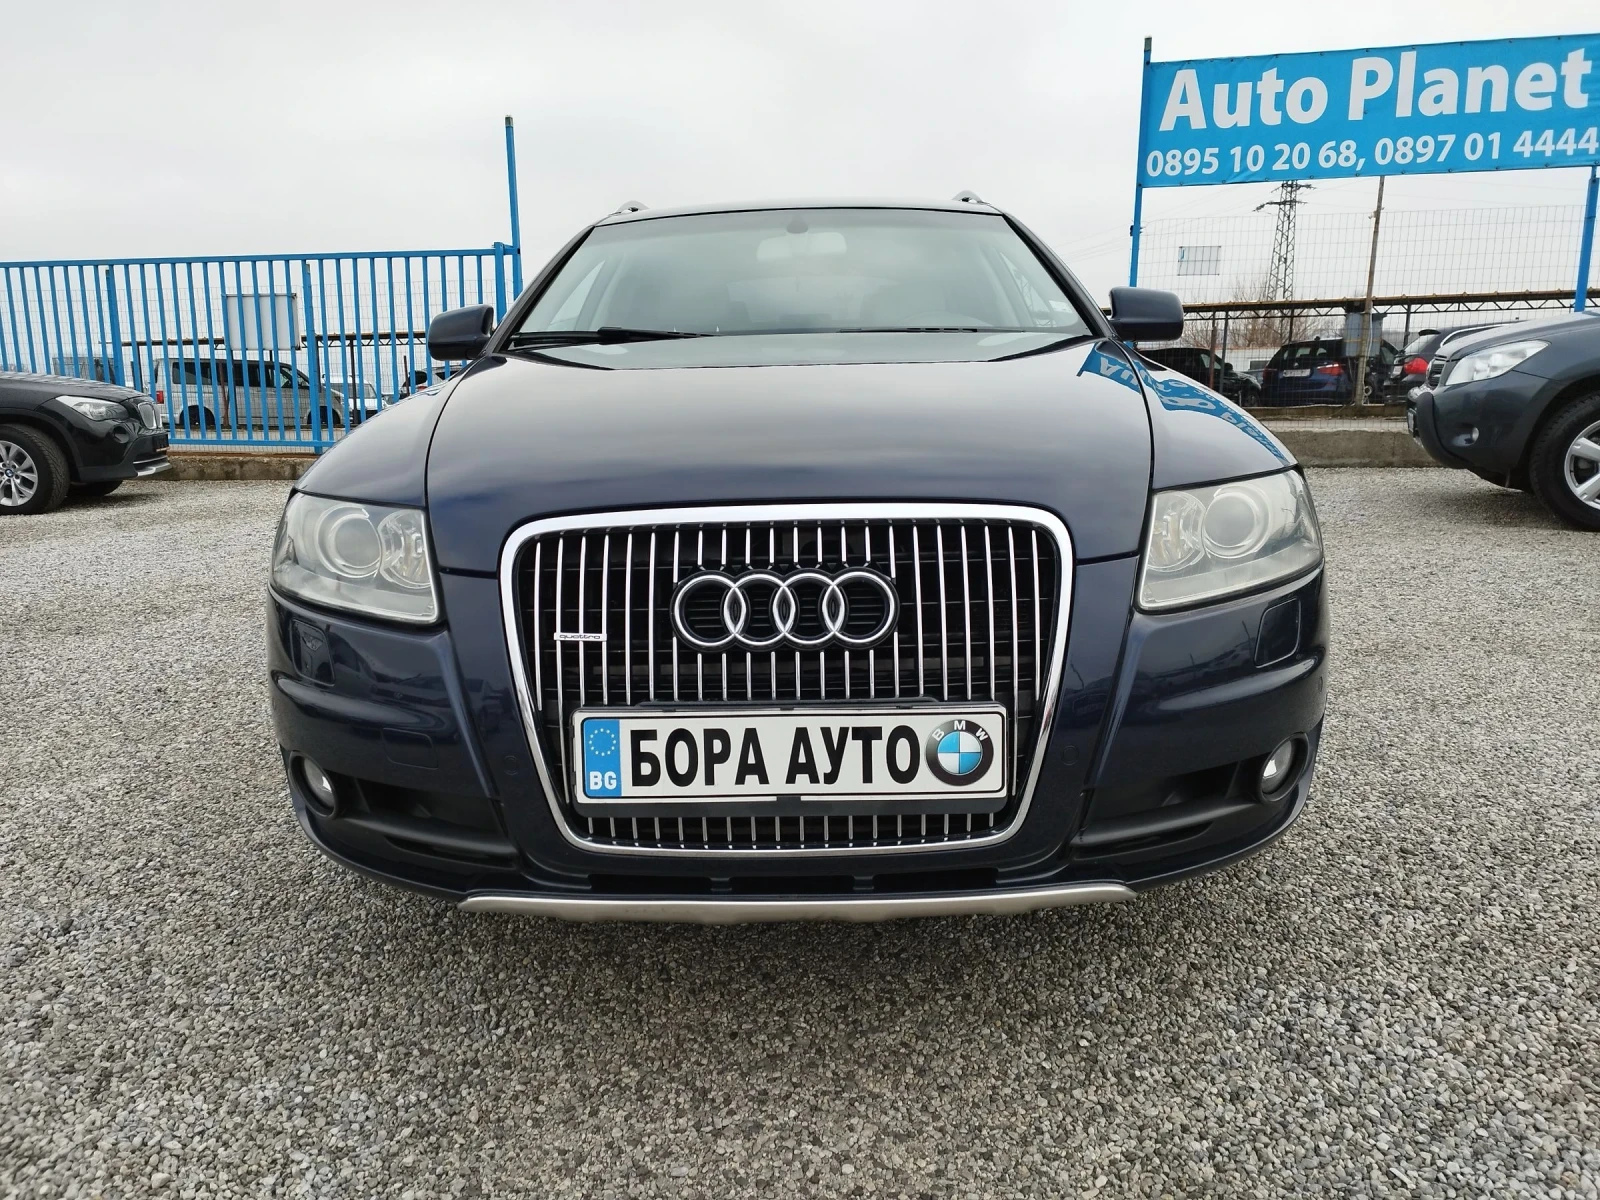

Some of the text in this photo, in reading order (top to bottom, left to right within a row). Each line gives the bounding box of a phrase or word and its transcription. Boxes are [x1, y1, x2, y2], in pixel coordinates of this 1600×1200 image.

[1159, 48, 1593, 132] Auto Planet
[1146, 126, 1600, 177] 0895 10 20 68, 0897 01 4444
[630, 724, 921, 788] БОРА АУТО
[931, 720, 989, 742] BMW
[589, 771, 618, 790] BG
